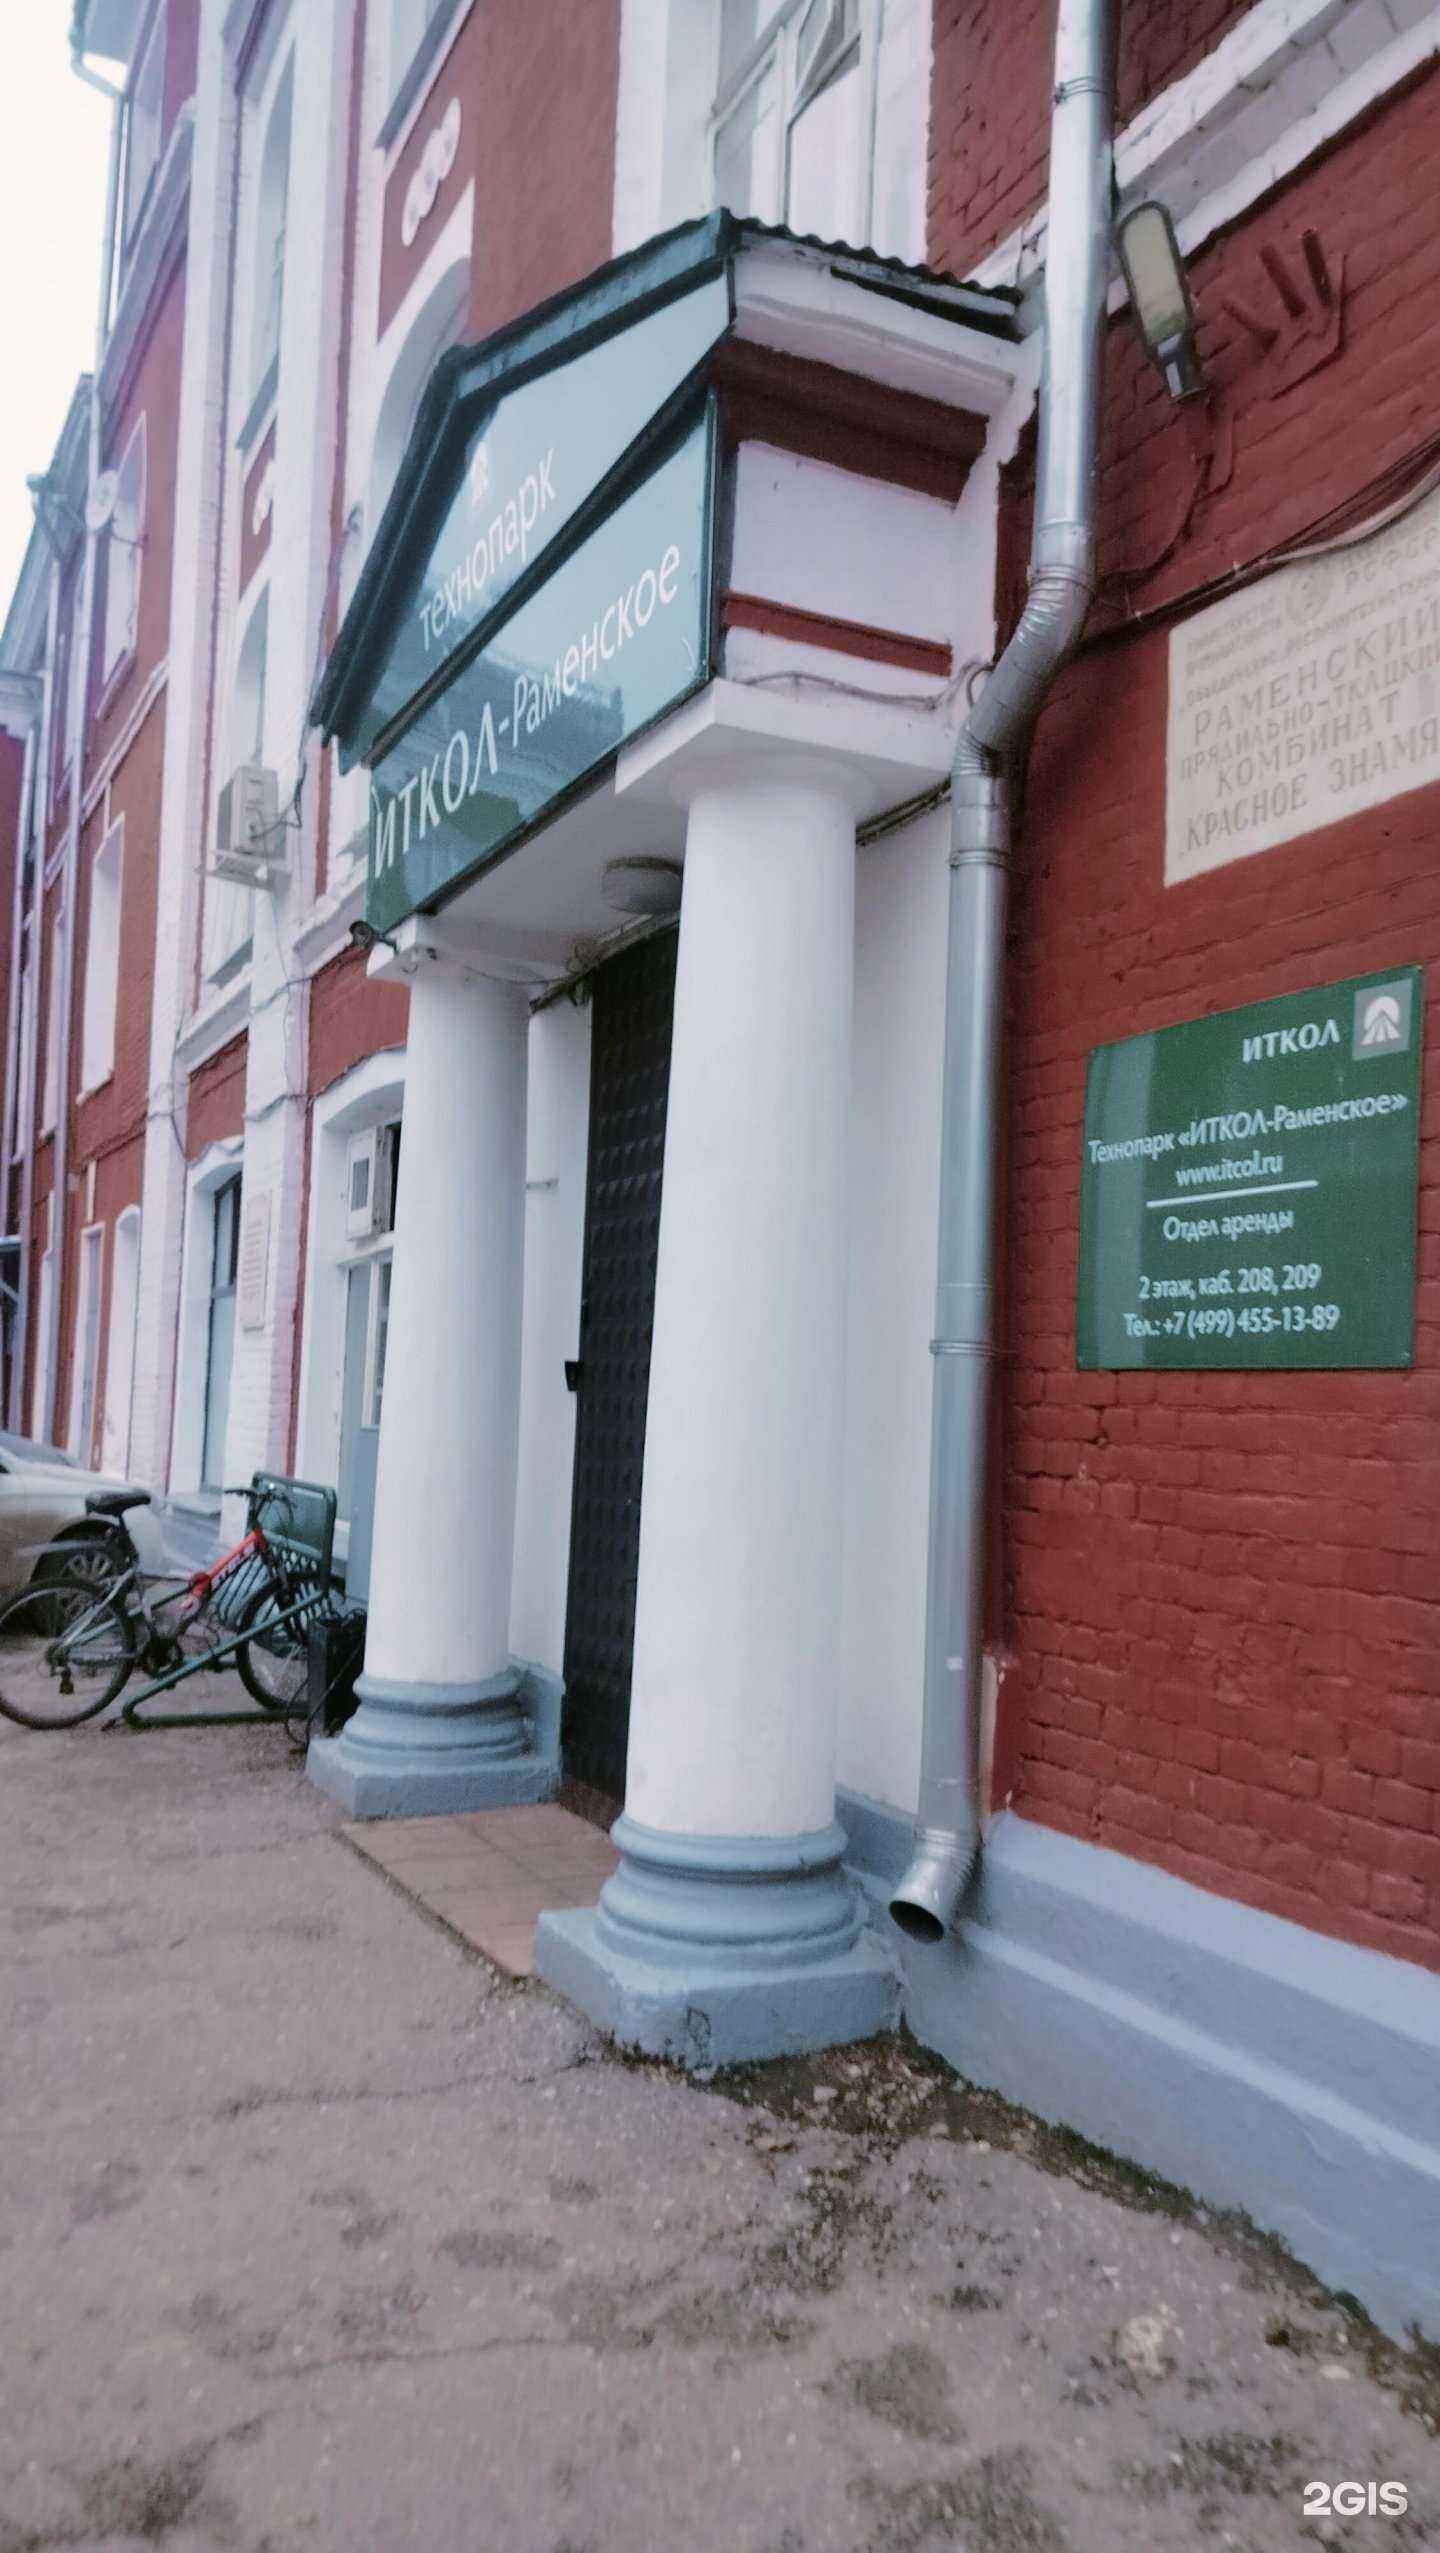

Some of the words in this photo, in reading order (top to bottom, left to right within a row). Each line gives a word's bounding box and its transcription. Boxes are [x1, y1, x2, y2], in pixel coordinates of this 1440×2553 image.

[419, 448, 558, 651] технопарк
[374, 544, 681, 878] ИТКОЛ-Раменское
[1216, 690, 1399, 800] КОМБИНАТ
[1328, 715, 1440, 794] ЗНАМЯ
[1242, 1019, 1340, 1063] ИТКОЛ
[1088, 1131, 1175, 1164] Технопарк
[1178, 1093, 1408, 1147] «ИТКОЛ-Раменское»
[1175, 1150, 1284, 1187] www.itcol.ru
[1163, 1215, 1219, 1243] Отдел
[1221, 1210, 1294, 1242] аренды
[1138, 1275, 1150, 1300] 2
[1151, 1279, 1196, 1301] этаж,
[1198, 1269, 1234, 1295] каб.
[1237, 1266, 1278, 1296] 208,
[1281, 1263, 1322, 1291] 209
[1123, 1312, 1160, 1338] Тел.:
[1162, 1310, 1186, 1335] +7
[1186, 1307, 1235, 1340] (499)
[1236, 1303, 1341, 1334] 455-13-89
